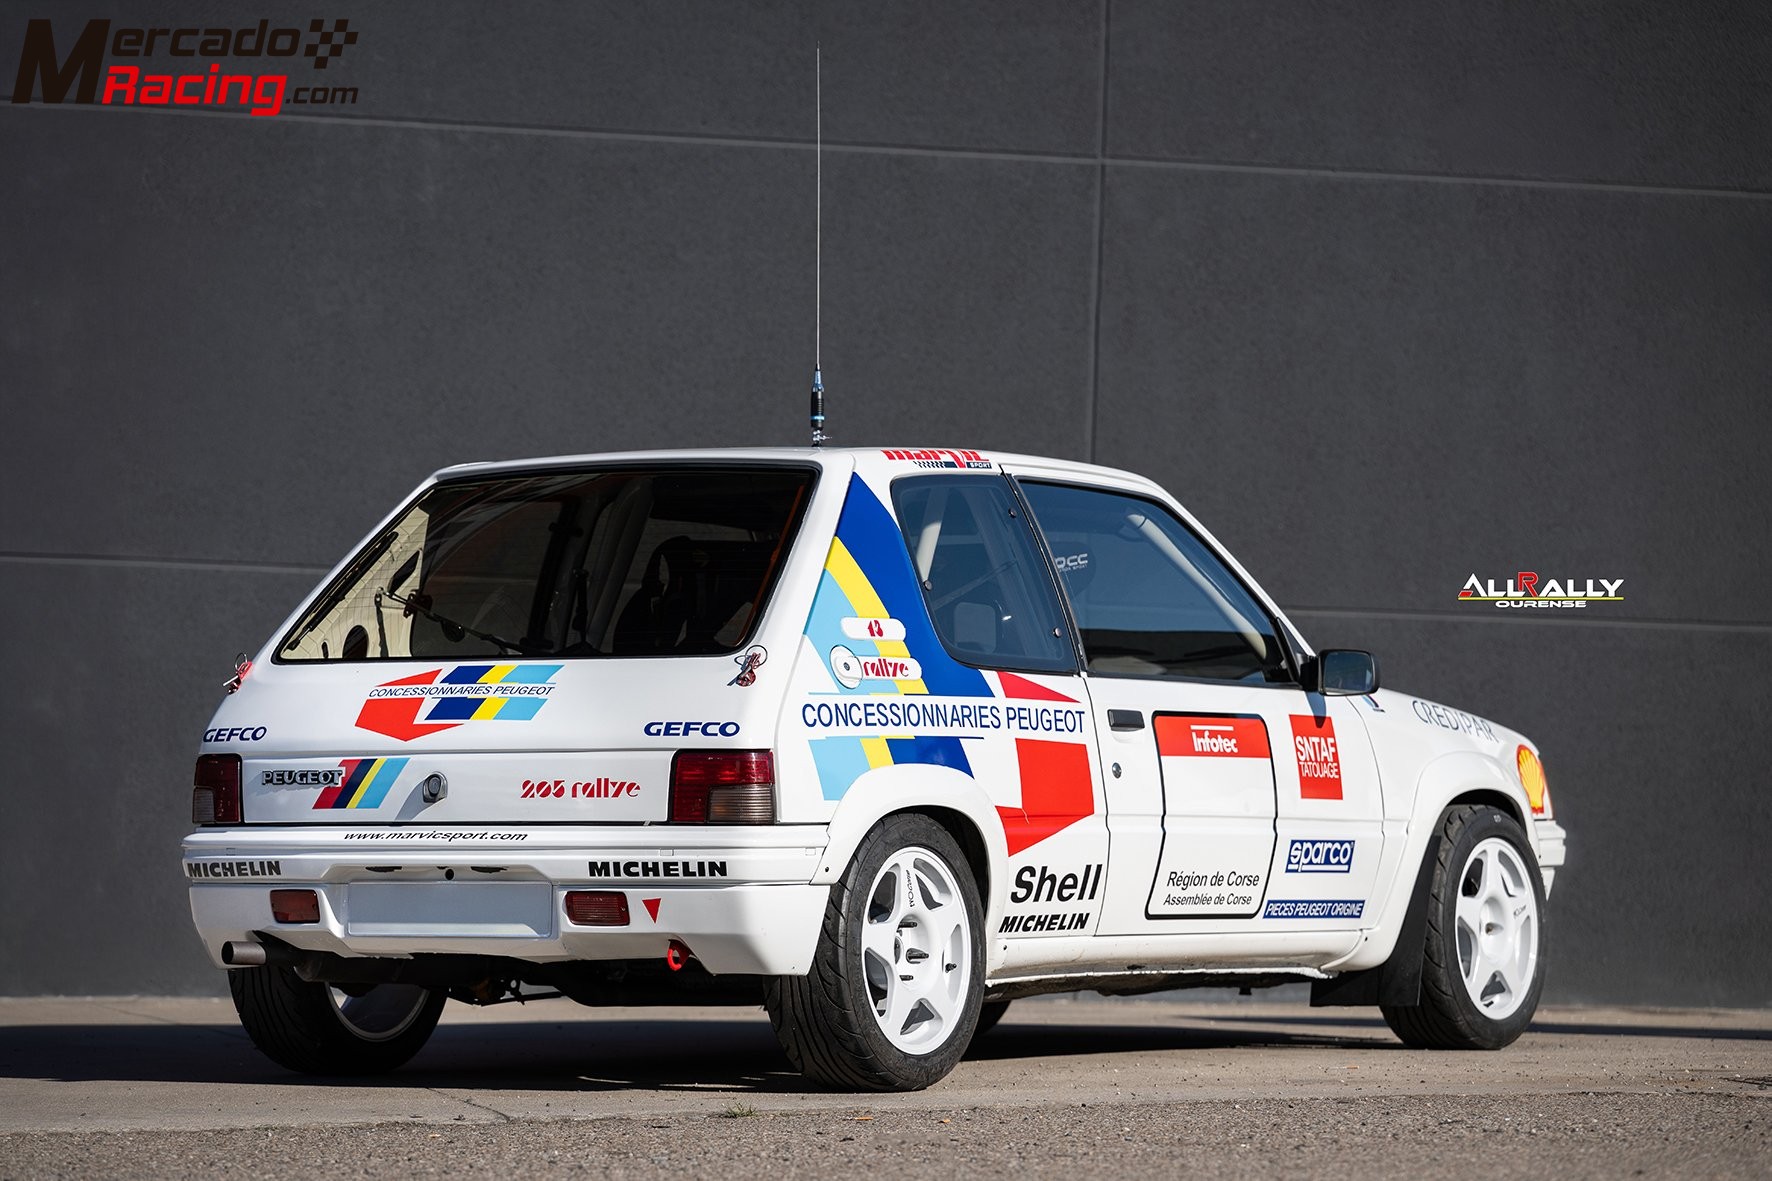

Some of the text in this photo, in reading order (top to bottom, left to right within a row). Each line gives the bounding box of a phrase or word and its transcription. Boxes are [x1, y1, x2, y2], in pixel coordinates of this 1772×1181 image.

[970, 461, 991, 469] SPORT
[863, 658, 910, 677] rallye
[368, 685, 555, 698] CONCESSIONNARIES PEUGEOT
[801, 703, 1086, 734] CONCESSIONNARIES PEUGEOT
[1412, 700, 1500, 743] CREDIPAR
[203, 726, 267, 743] GEFCO
[644, 721, 741, 737] GEFCO
[1191, 730, 1239, 753] Infotec
[1295, 735, 1336, 763] SNTAF
[262, 769, 344, 786] PEUGEOT
[1299, 761, 1340, 779] TATOUAGE
[520, 777, 641, 798] 205 rallye
[343, 830, 529, 842] www.marvicsport.com
[1290, 841, 1352, 872] sparco
[187, 861, 281, 878] MICHELIN
[588, 861, 727, 877] MICHELIN
[1010, 863, 1103, 904] Shell
[1167, 870, 1260, 891] Région de Corse
[1163, 893, 1252, 905] Assemblée de Corse
[1265, 902, 1363, 916] PIECES PEUGEOT ORIGINE
[998, 912, 1090, 933] MICHELIN
